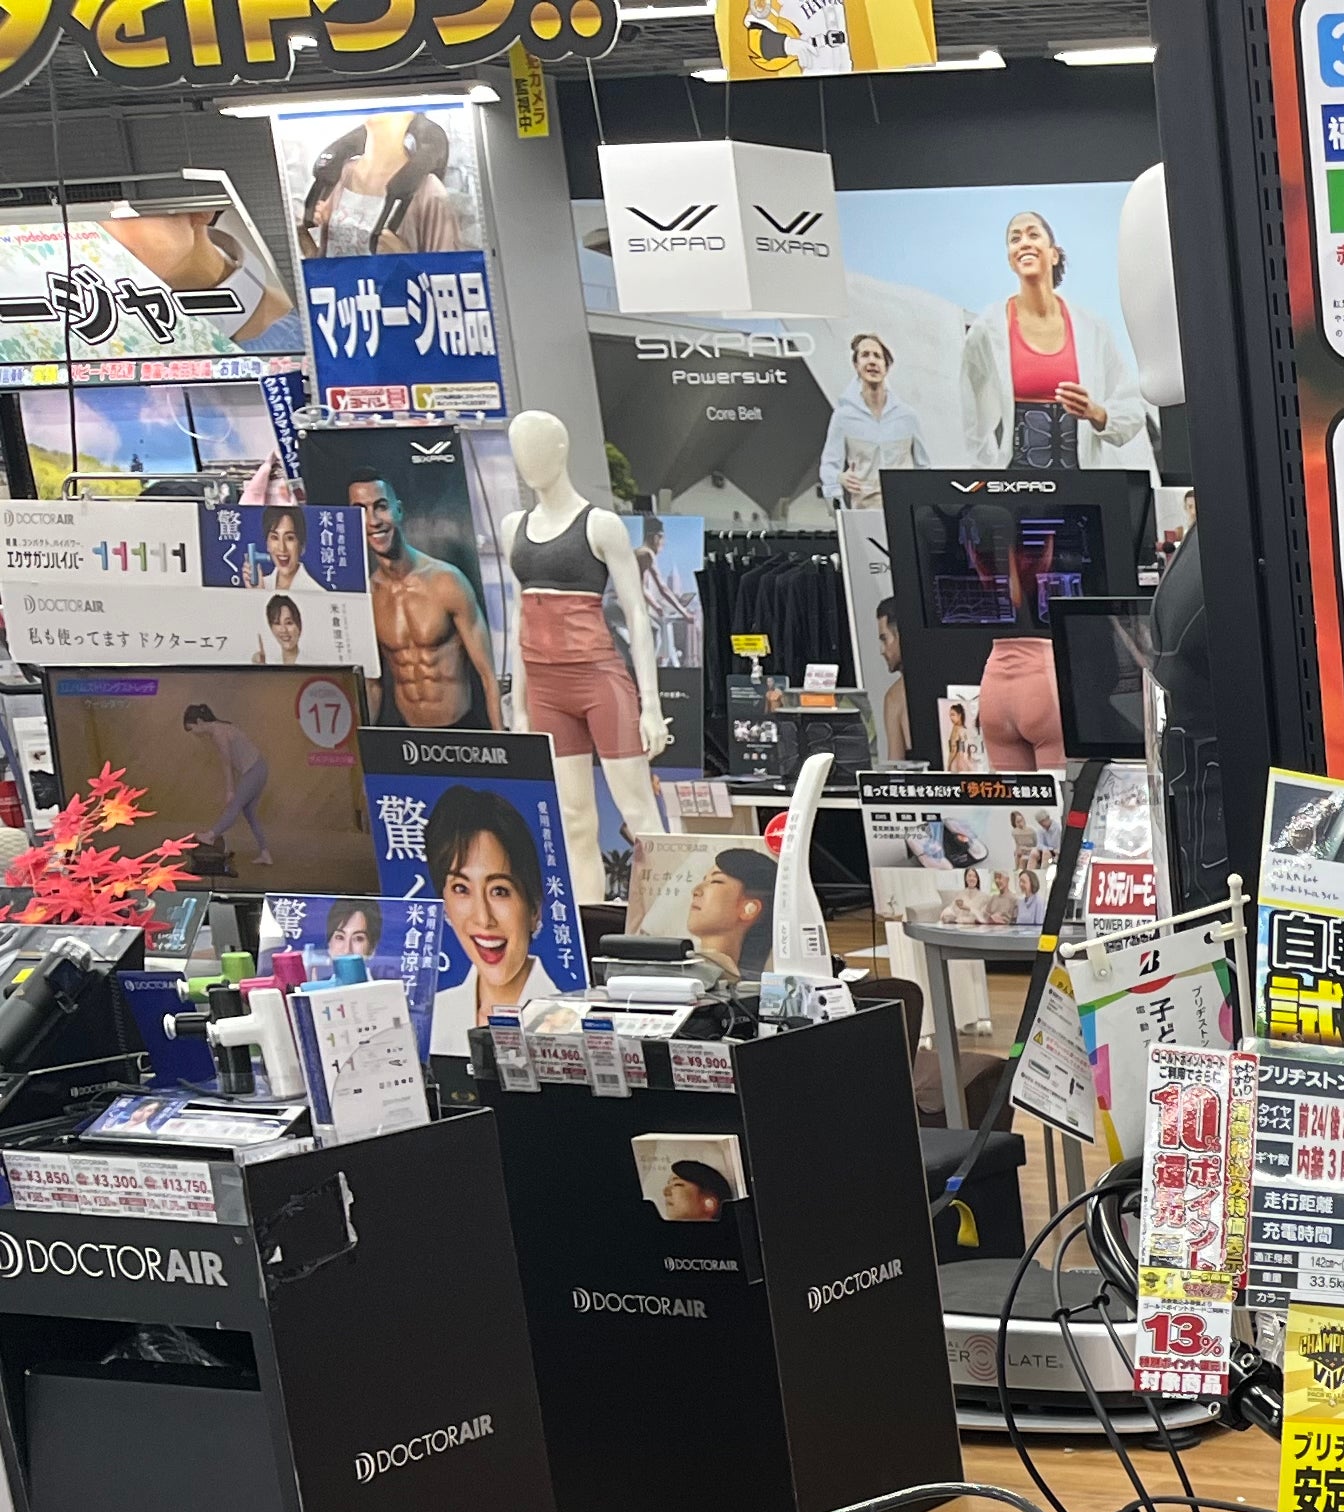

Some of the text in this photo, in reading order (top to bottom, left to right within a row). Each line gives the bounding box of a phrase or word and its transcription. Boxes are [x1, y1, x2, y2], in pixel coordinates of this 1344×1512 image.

[628, 235, 726, 253] SIXPAD
[755, 235, 831, 258] SIXPAD
[309, 271, 497, 358] マッサージ用品
[633, 331, 816, 361] SIXPAD
[671, 368, 788, 385] Powersuit
[986, 480, 1056, 494] SIXPAD
[306, 702, 342, 736] 17
[420, 743, 509, 766] DOCTORAIR
[1263, 1191, 1333, 1215] 走行距離
[1262, 1221, 1333, 1245] 充電時間
[29, 1240, 229, 1288] DOCTORAIR
[822, 1257, 904, 1305] DOCTORAIR
[592, 1290, 708, 1320] DOCTORAIR
[1143, 1313, 1224, 1357] 13%
[376, 1413, 495, 1473] DOCTORAIR
